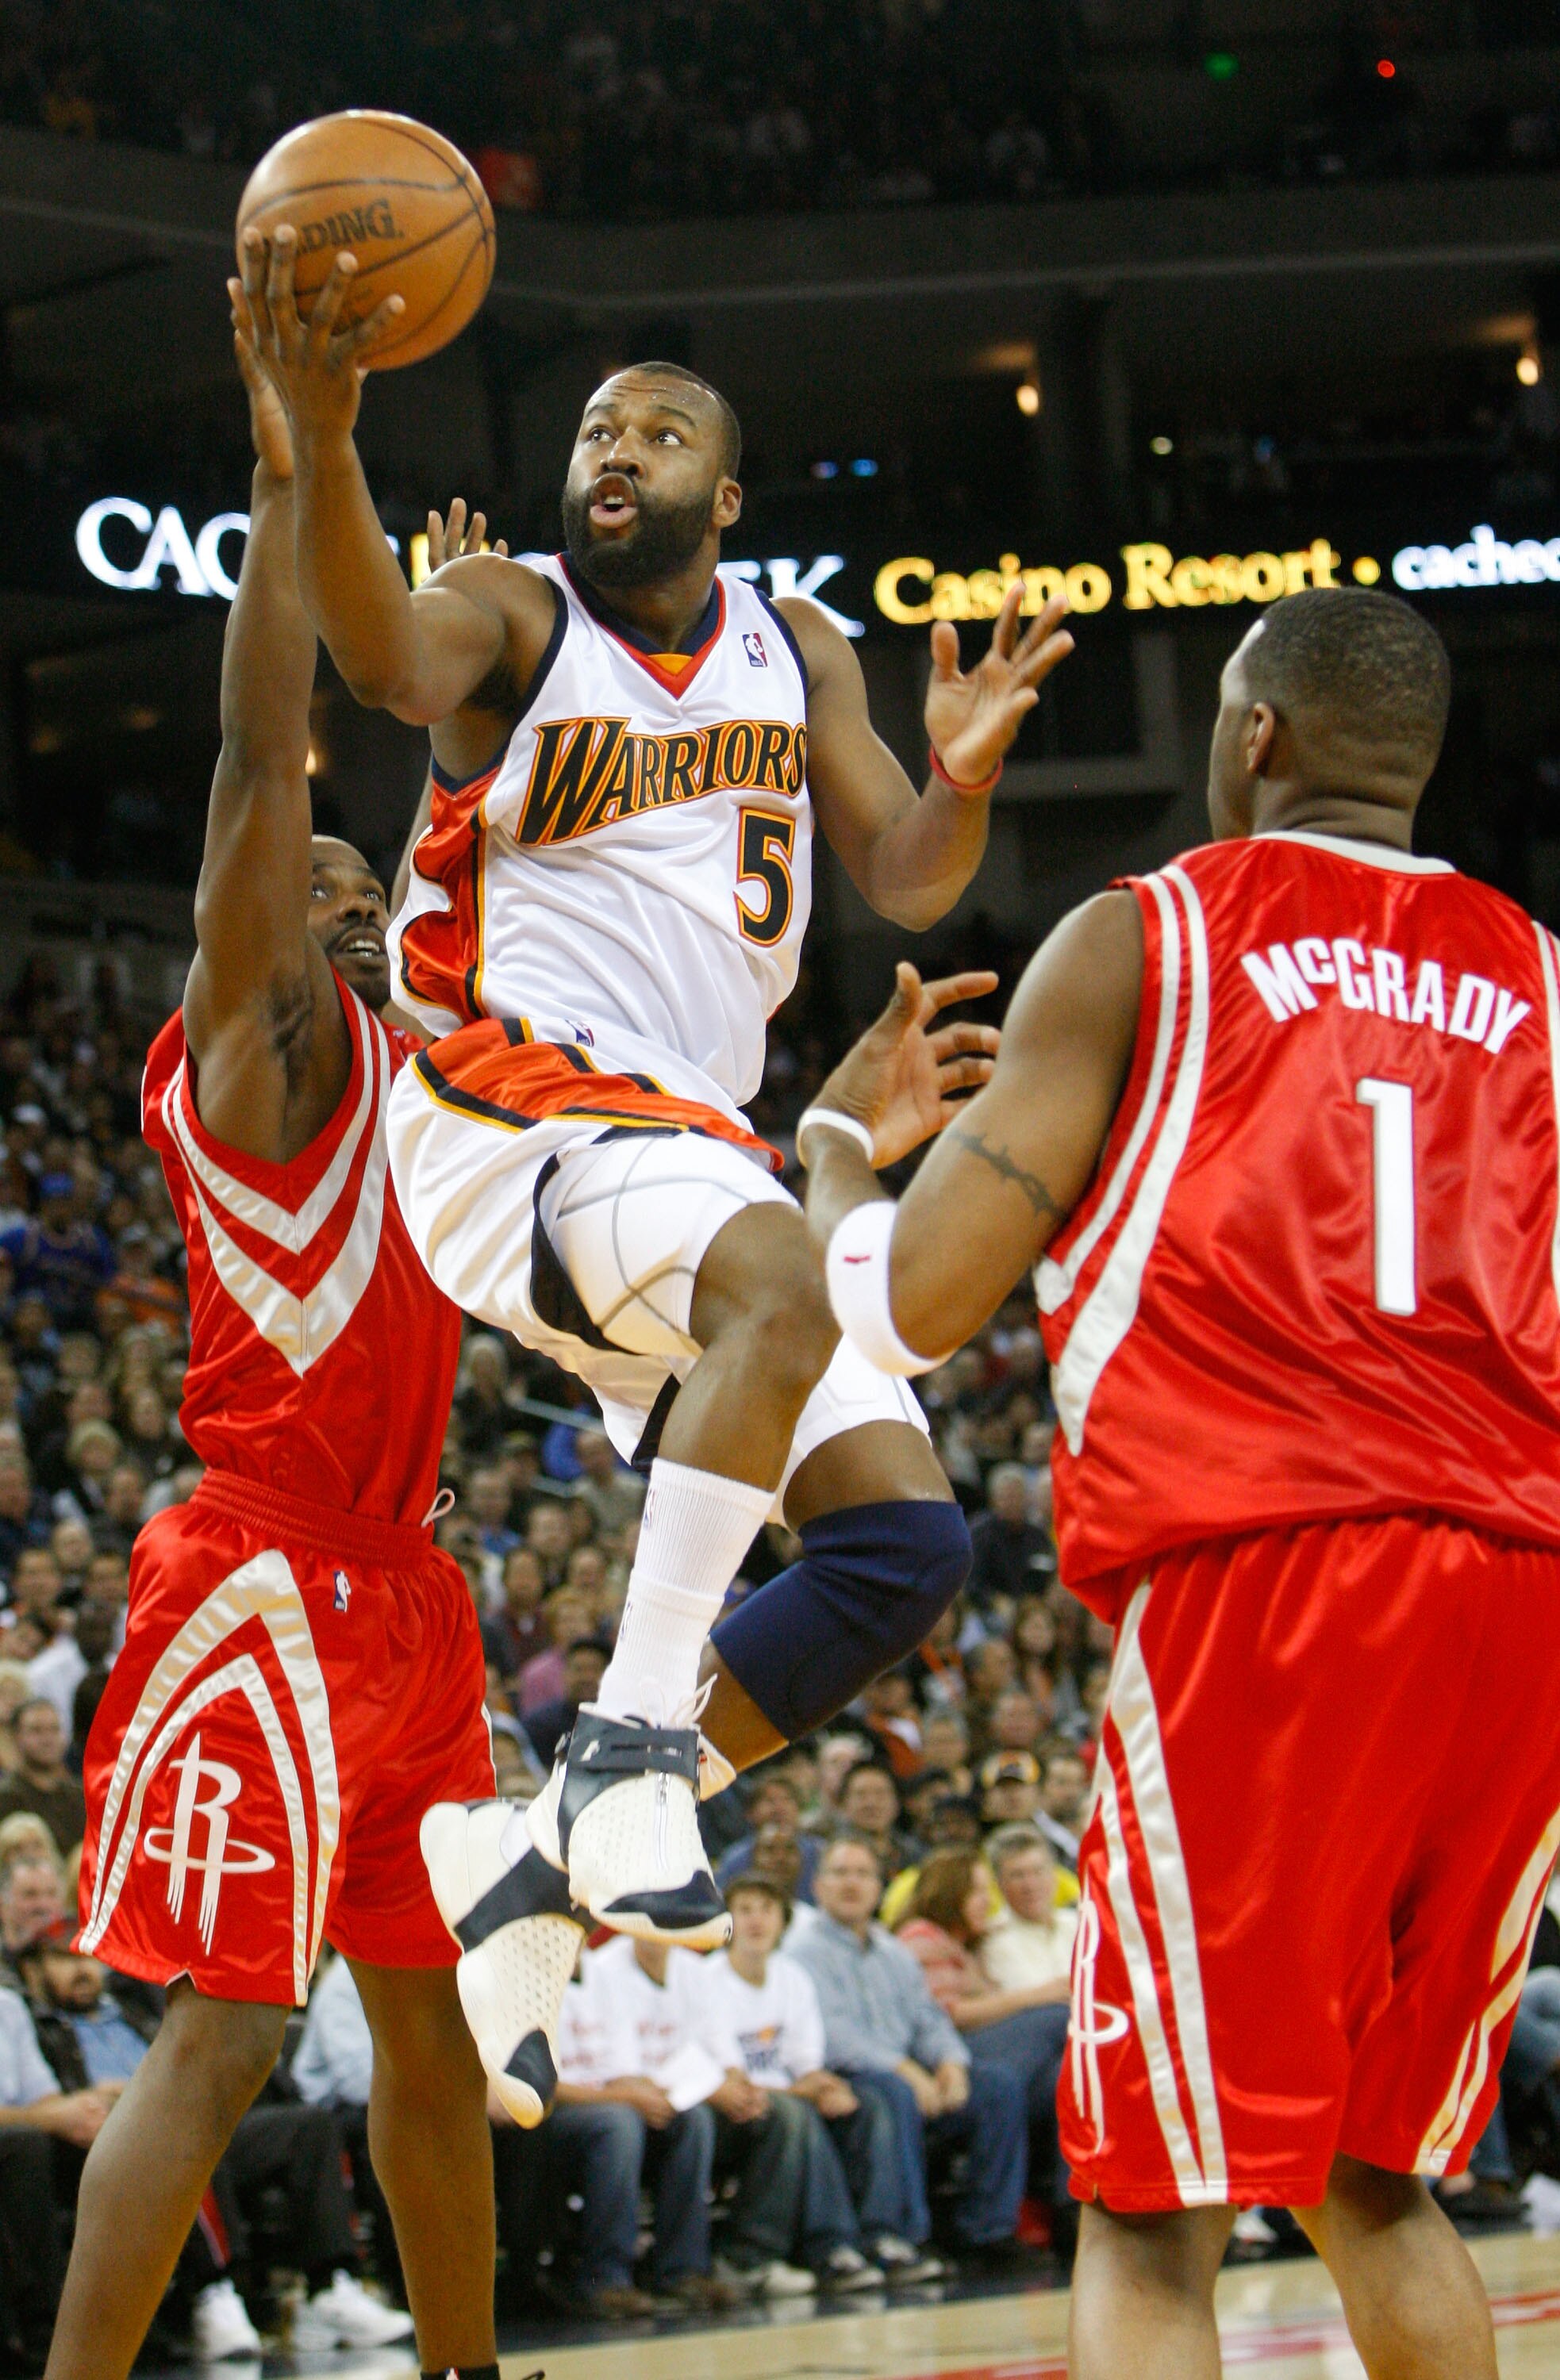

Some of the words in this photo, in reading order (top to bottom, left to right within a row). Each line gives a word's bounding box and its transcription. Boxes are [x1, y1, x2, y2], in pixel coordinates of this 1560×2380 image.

[76, 497, 252, 601] CAC
[874, 552, 1112, 624] Casino
[1121, 538, 1342, 610] Resort
[515, 716, 808, 847] WARRIORS
[733, 805, 797, 948] 5
[1356, 1077, 1416, 1317] 1
